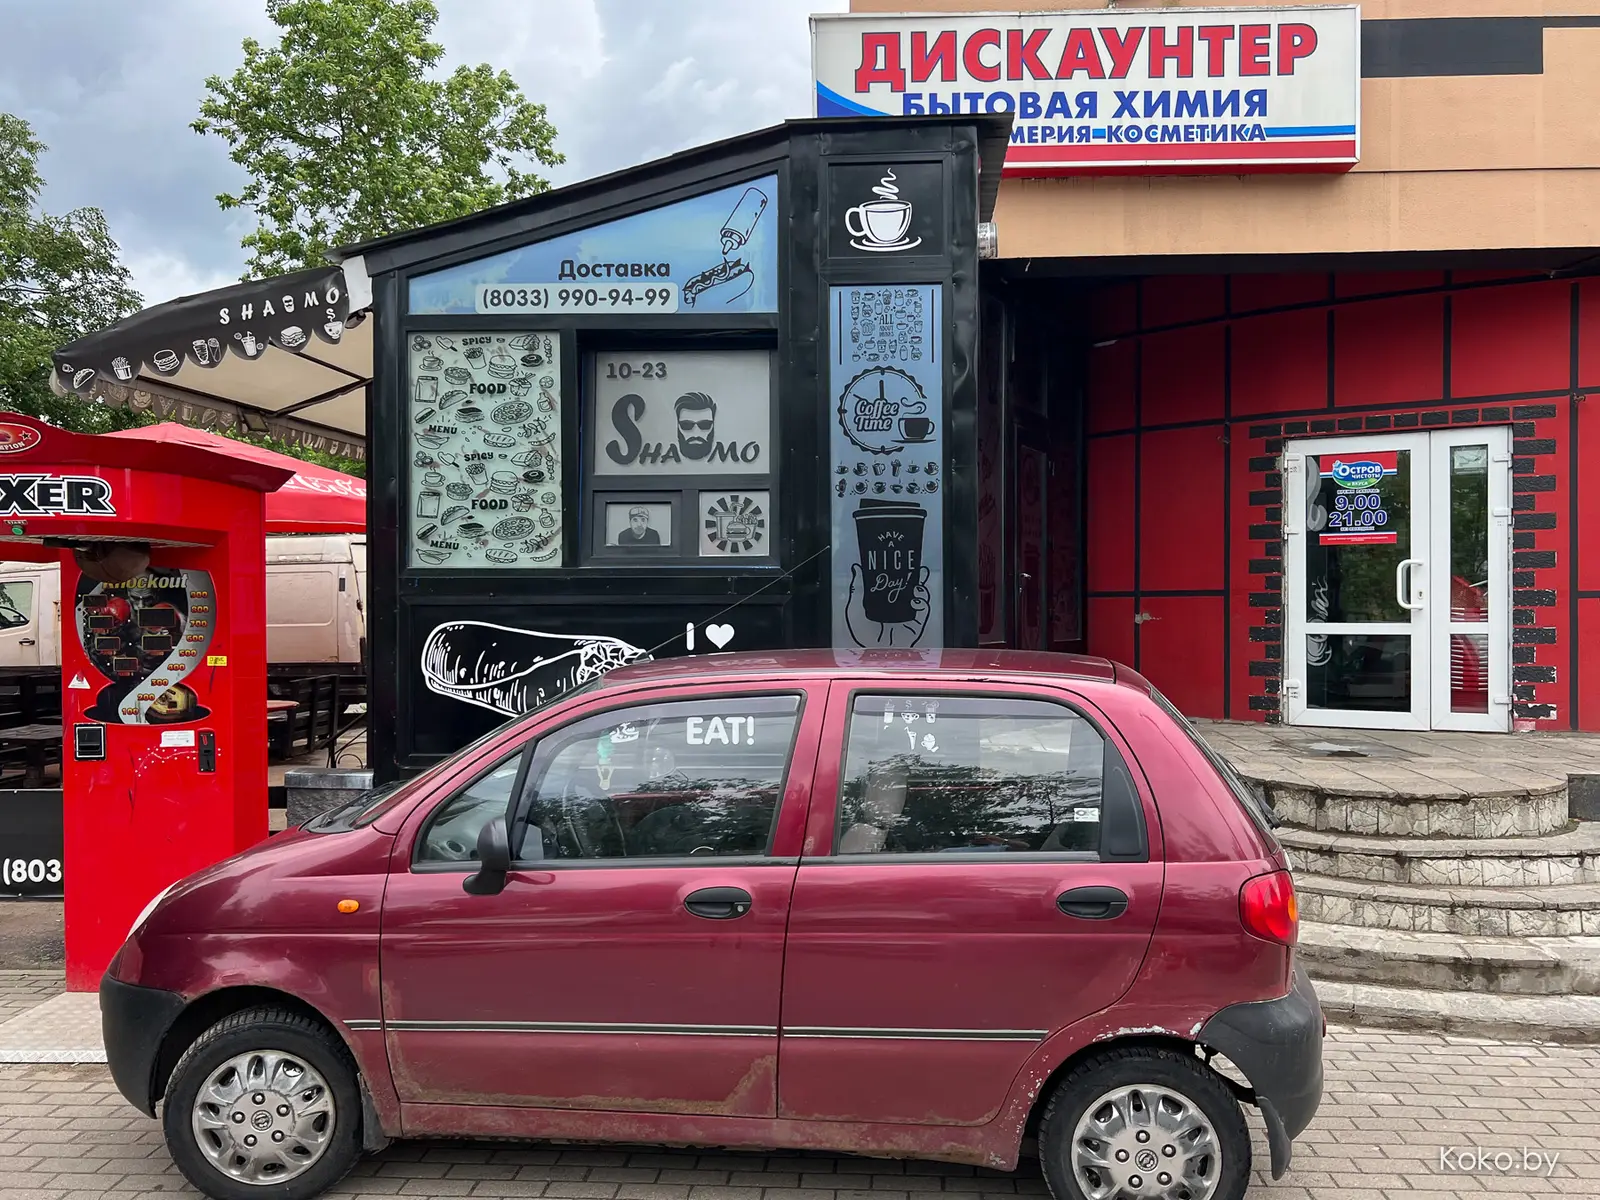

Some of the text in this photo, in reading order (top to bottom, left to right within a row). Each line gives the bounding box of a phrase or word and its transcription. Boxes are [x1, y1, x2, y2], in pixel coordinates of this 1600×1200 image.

[854, 23, 1318, 93] ДИСКАУНТЕР
[902, 88, 1269, 118] БЫТОВАЯ ХИМИЯ
[1009, 123, 1267, 144] МЕРИЯ КОСМЕТИКА
[557, 258, 670, 281] Доставка
[482, 287, 671, 309] (8033) 990-94-99
[879, 313, 895, 325] ALL
[462, 336, 492, 346] SPICY
[606, 362, 668, 380] 10-23
[469, 383, 507, 395] FOOD
[855, 399, 900, 419] Coffee
[428, 424, 458, 435] MENU
[854, 415, 893, 432] Time
[464, 451, 494, 462] SPICY
[0, 473, 117, 517] XER
[1335, 493, 1381, 511] 9.00
[471, 498, 508, 510] FOOD
[1328, 509, 1388, 527] 21.00
[877, 531, 905, 542] HAVE
[888, 540, 895, 548] A
[430, 540, 459, 551] MENU
[868, 550, 916, 571] NICE
[870, 571, 913, 604] Day!
[190, 619, 208, 628] 700
[178, 649, 197, 657] 500
[150, 679, 169, 687] 300
[137, 693, 155, 701] 200
[121, 707, 139, 716] 100
[686, 716, 756, 746] EAT!
[3, 858, 62, 886] (803
